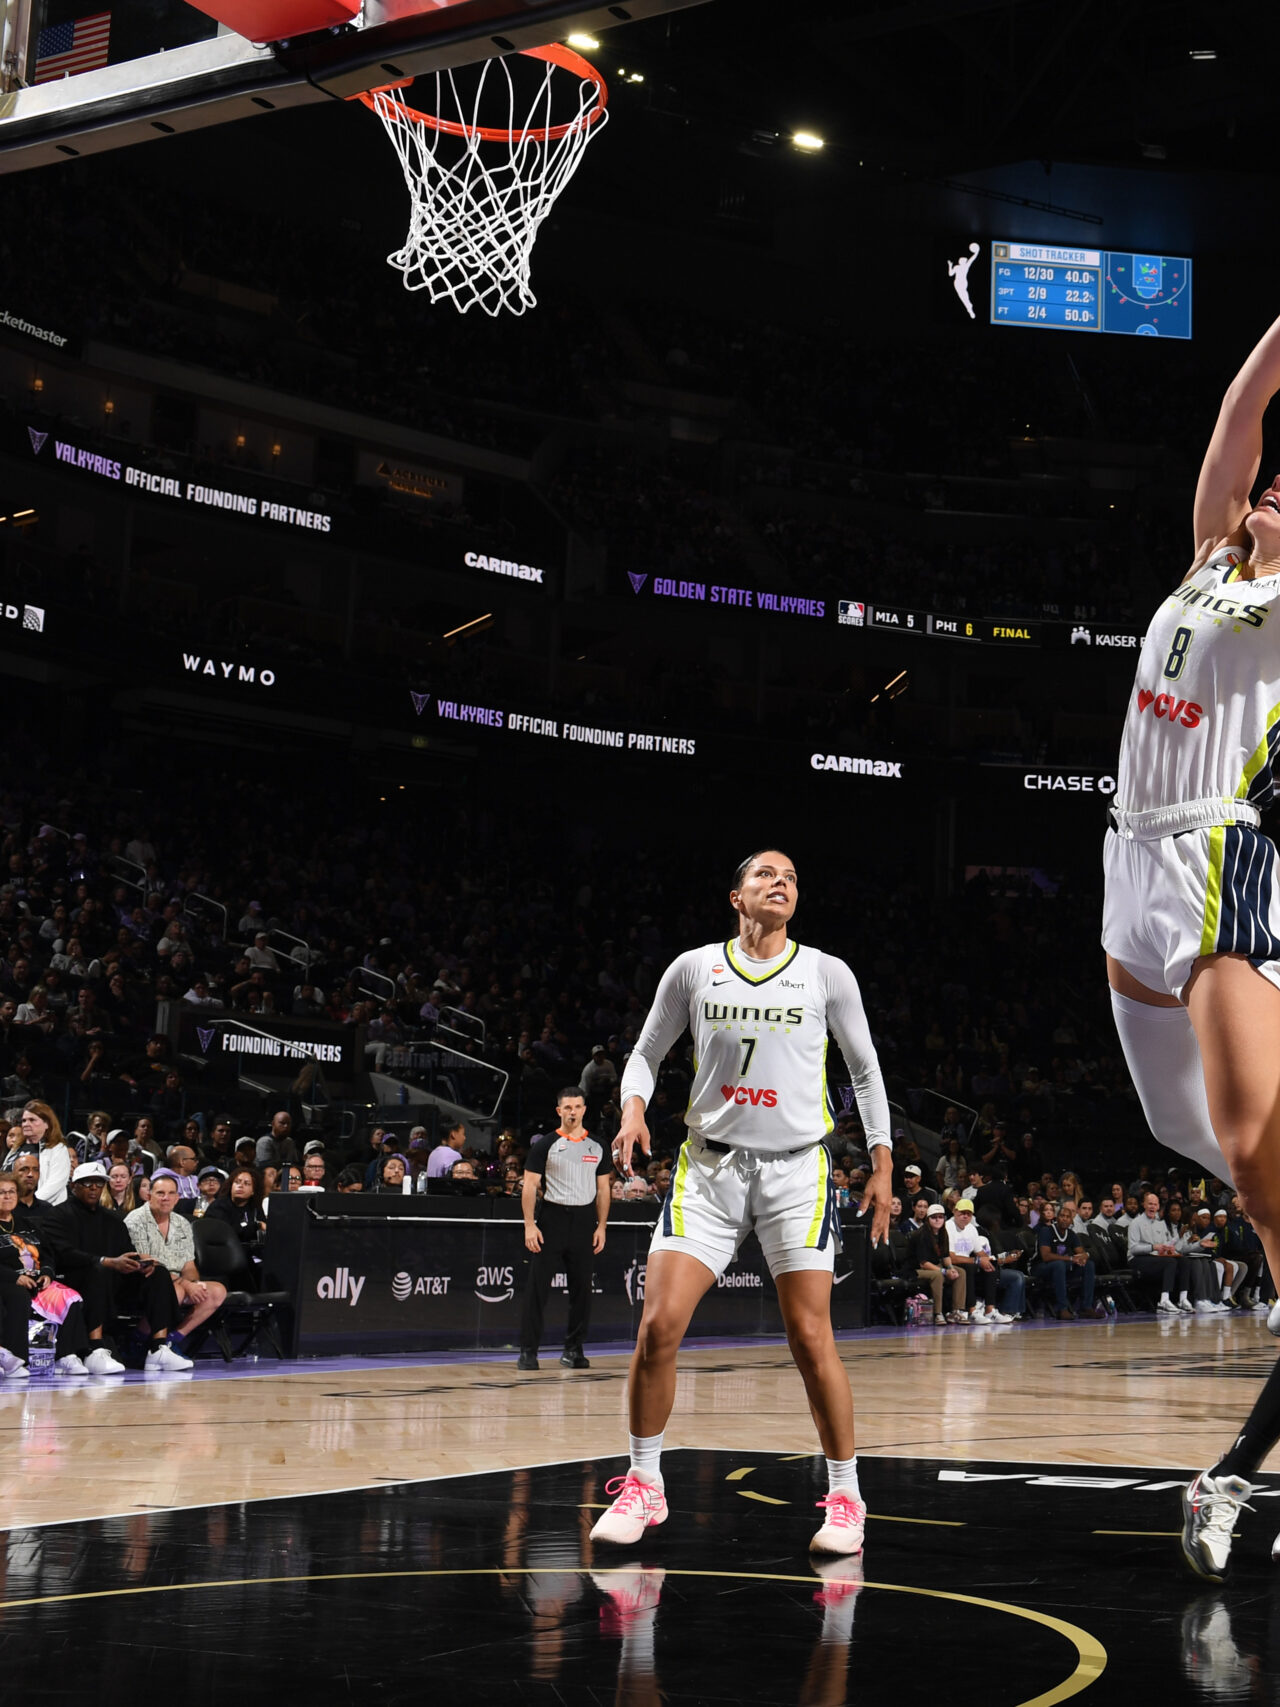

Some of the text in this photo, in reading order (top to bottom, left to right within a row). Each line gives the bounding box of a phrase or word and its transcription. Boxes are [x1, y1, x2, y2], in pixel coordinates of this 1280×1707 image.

[1020, 247, 1086, 263] SHOT TRACKER
[998, 267, 1011, 276] FG
[1024, 266, 1054, 281] 12/30
[998, 287, 1014, 296] 3PT
[1028, 286, 1047, 300] 2/9
[998, 306, 1008, 315] FT
[1028, 305, 1047, 319] 2/4
[55, 441, 331, 532] VALKYRIES OFFICIAL FOUNDING PARTNERS
[654, 578, 826, 617] GOLDEN STATE VALKYRIES
[838, 616, 864, 626] SCORES
[876, 612, 1031, 639] MIA 5 PHI 6 FINAL
[1095, 634, 1136, 647] KAISER
[1164, 627, 1193, 679] 8
[183, 653, 275, 686] WAYMO
[1153, 693, 1203, 729] CVS
[437, 700, 696, 755] VALKYRIES OFFICIAL FOUNDING PARTNERS
[1024, 775, 1094, 792] CHASE
[778, 979, 806, 989] Albert
[704, 1001, 804, 1025] WINGS
[712, 1024, 791, 1034] DALLAS
[222, 1034, 281, 1056] FOUNDING
[739, 1037, 758, 1077] 7
[735, 1086, 778, 1108] CVS
[317, 1268, 366, 1306] ally
[414, 1277, 450, 1295] AT&T
[476, 1266, 513, 1287] aws
